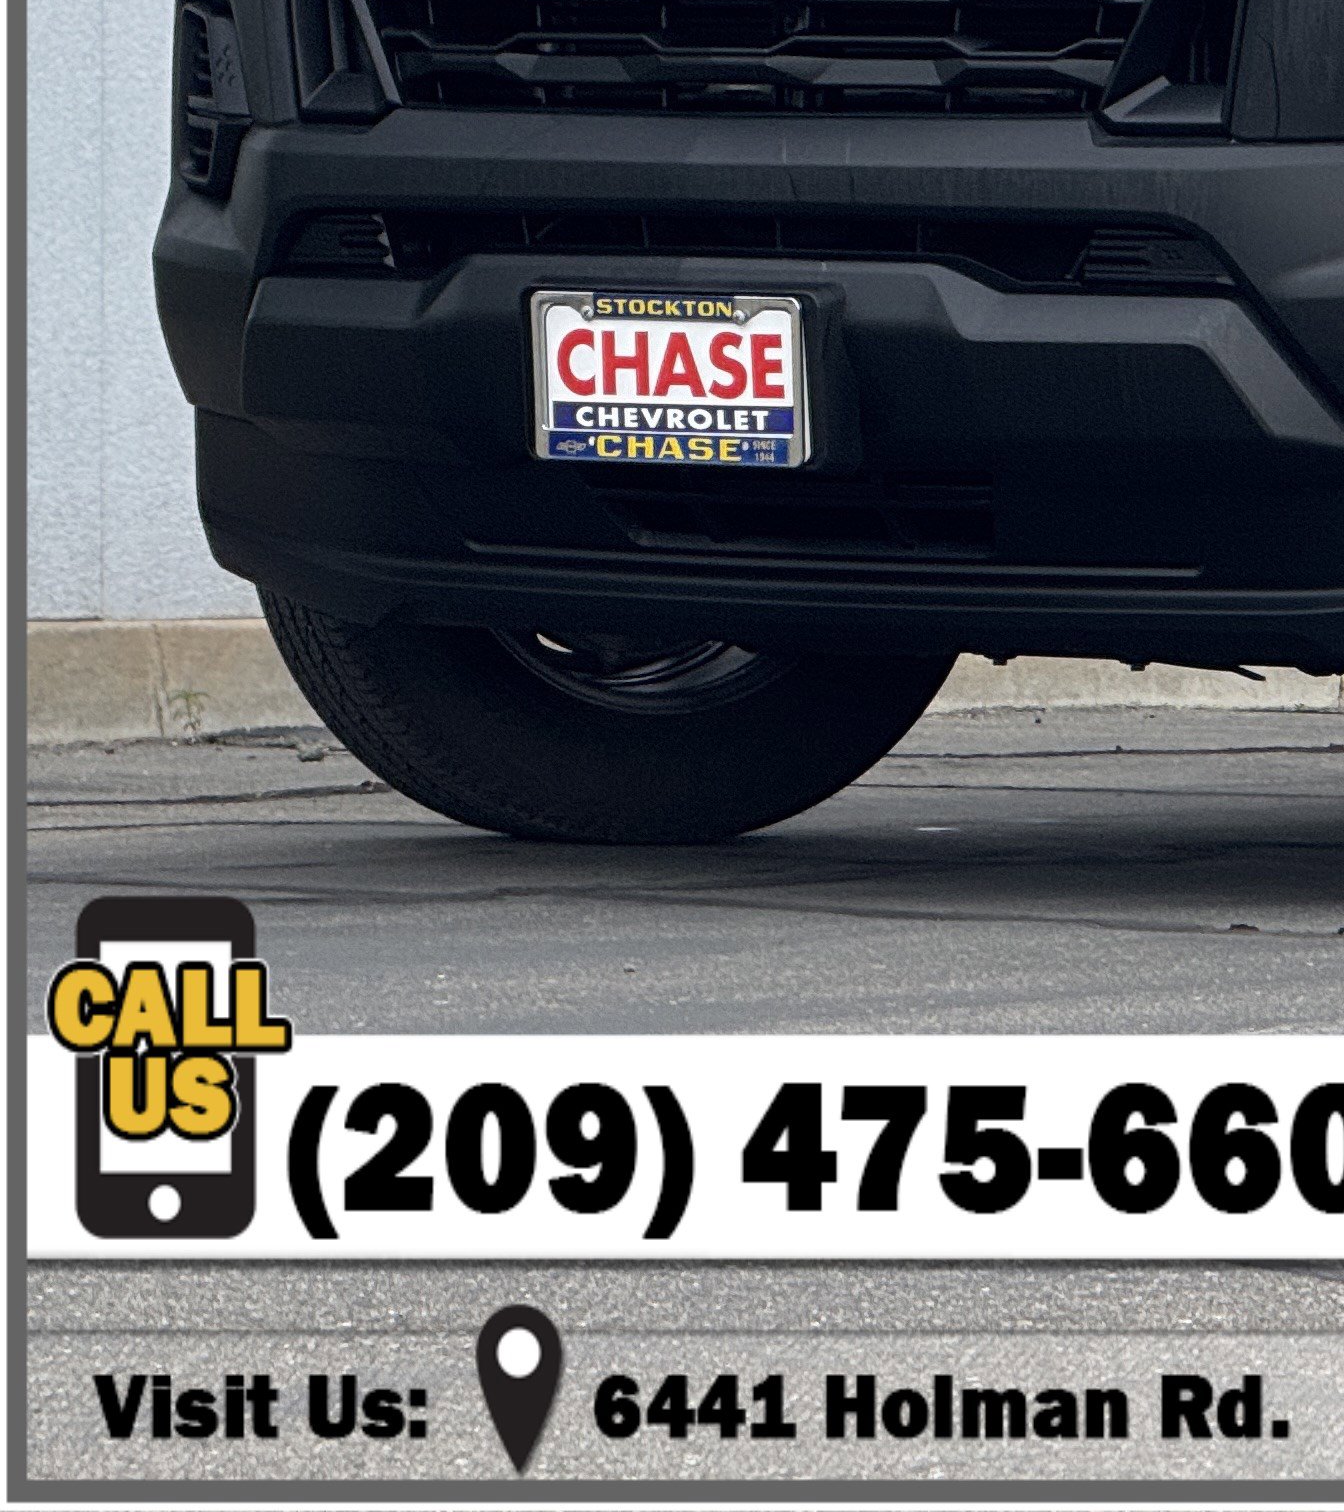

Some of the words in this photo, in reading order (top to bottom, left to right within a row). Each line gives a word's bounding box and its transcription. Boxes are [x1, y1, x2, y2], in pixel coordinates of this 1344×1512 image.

[596, 299, 733, 317] STOCKTON
[557, 328, 785, 399] CHASE
[575, 406, 769, 430] CHEVROLET
[596, 435, 742, 461] CHASE
